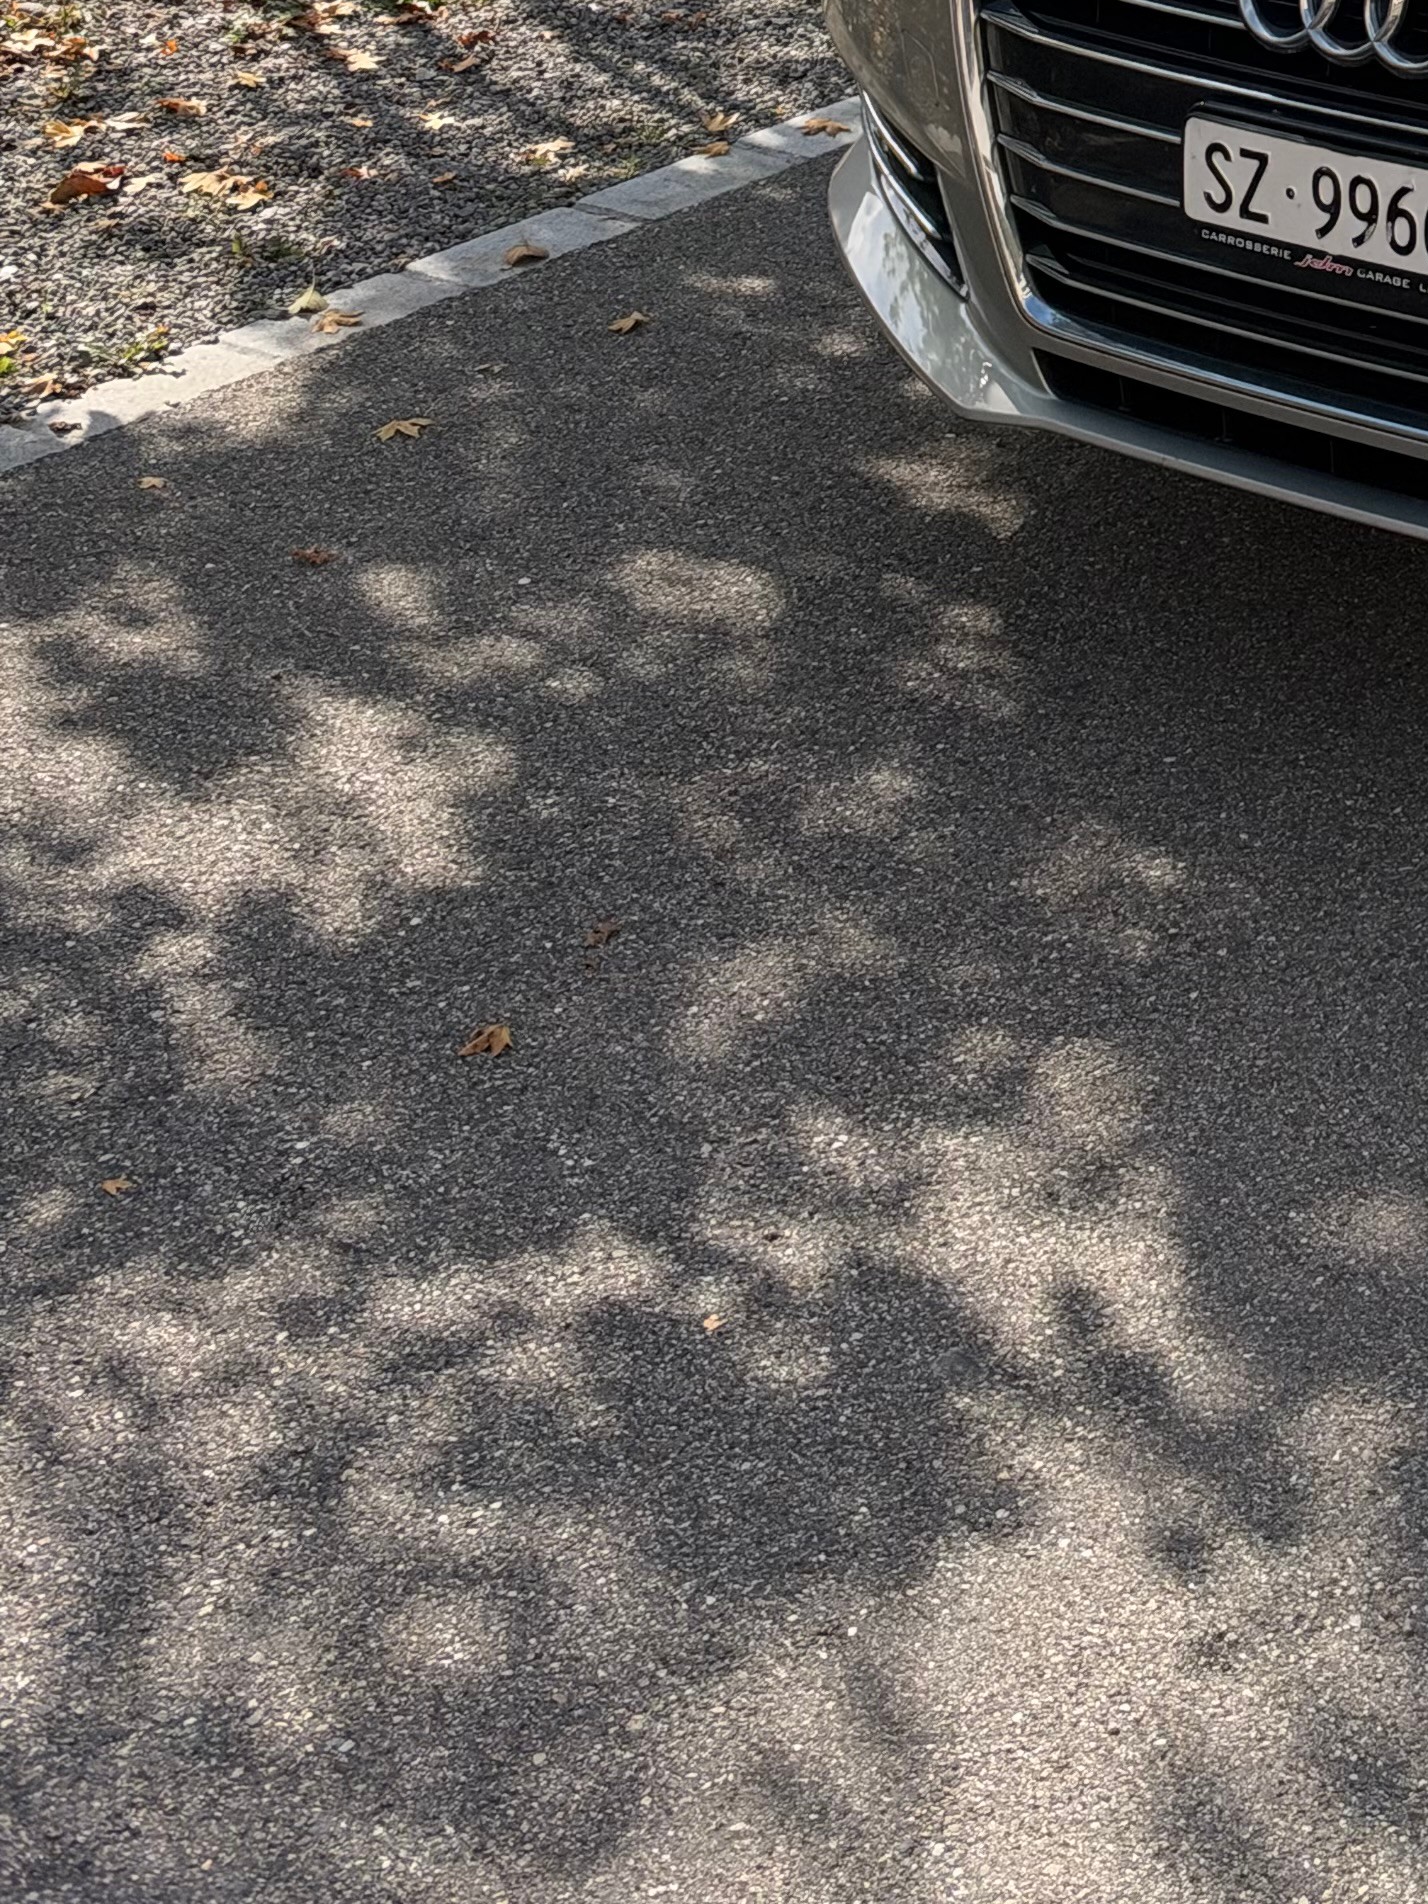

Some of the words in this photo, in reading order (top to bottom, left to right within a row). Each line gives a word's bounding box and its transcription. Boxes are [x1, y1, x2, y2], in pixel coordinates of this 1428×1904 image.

[1203, 142, 1270, 225] SZ
[1201, 228, 1292, 261] CARROSSERIE
[1356, 268, 1411, 289] GARAGE
